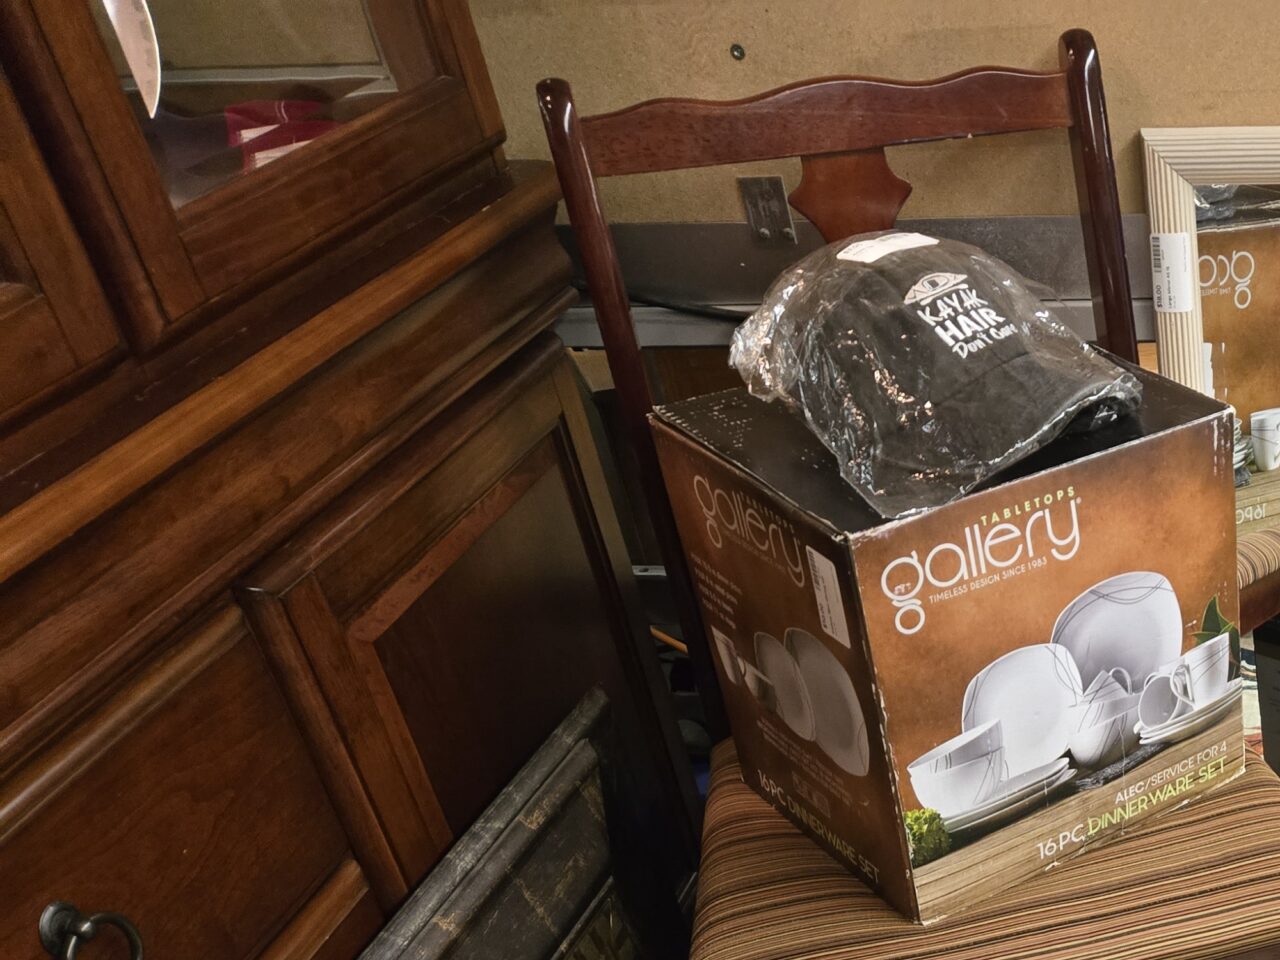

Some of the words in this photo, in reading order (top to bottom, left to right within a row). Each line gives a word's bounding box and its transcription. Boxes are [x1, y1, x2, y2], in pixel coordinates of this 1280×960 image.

[917, 289, 988, 326] KAYAK
[935, 307, 1006, 347] HAIR
[981, 486, 1076, 527] TABLETOPS
[694, 475, 805, 587] gallery
[881, 499, 1080, 635] gallery
[929, 585, 968, 604] TIMELESS
[970, 572, 1000, 591] DESIGN
[1002, 565, 1026, 580] SINCE
[1197, 746, 1219, 766] FOR
[1219, 741, 1228, 753] 4
[758, 769, 769, 790] 16
[858, 855, 880, 884] SET
[1037, 839, 1057, 860] 16
[1199, 756, 1228, 783] SET
